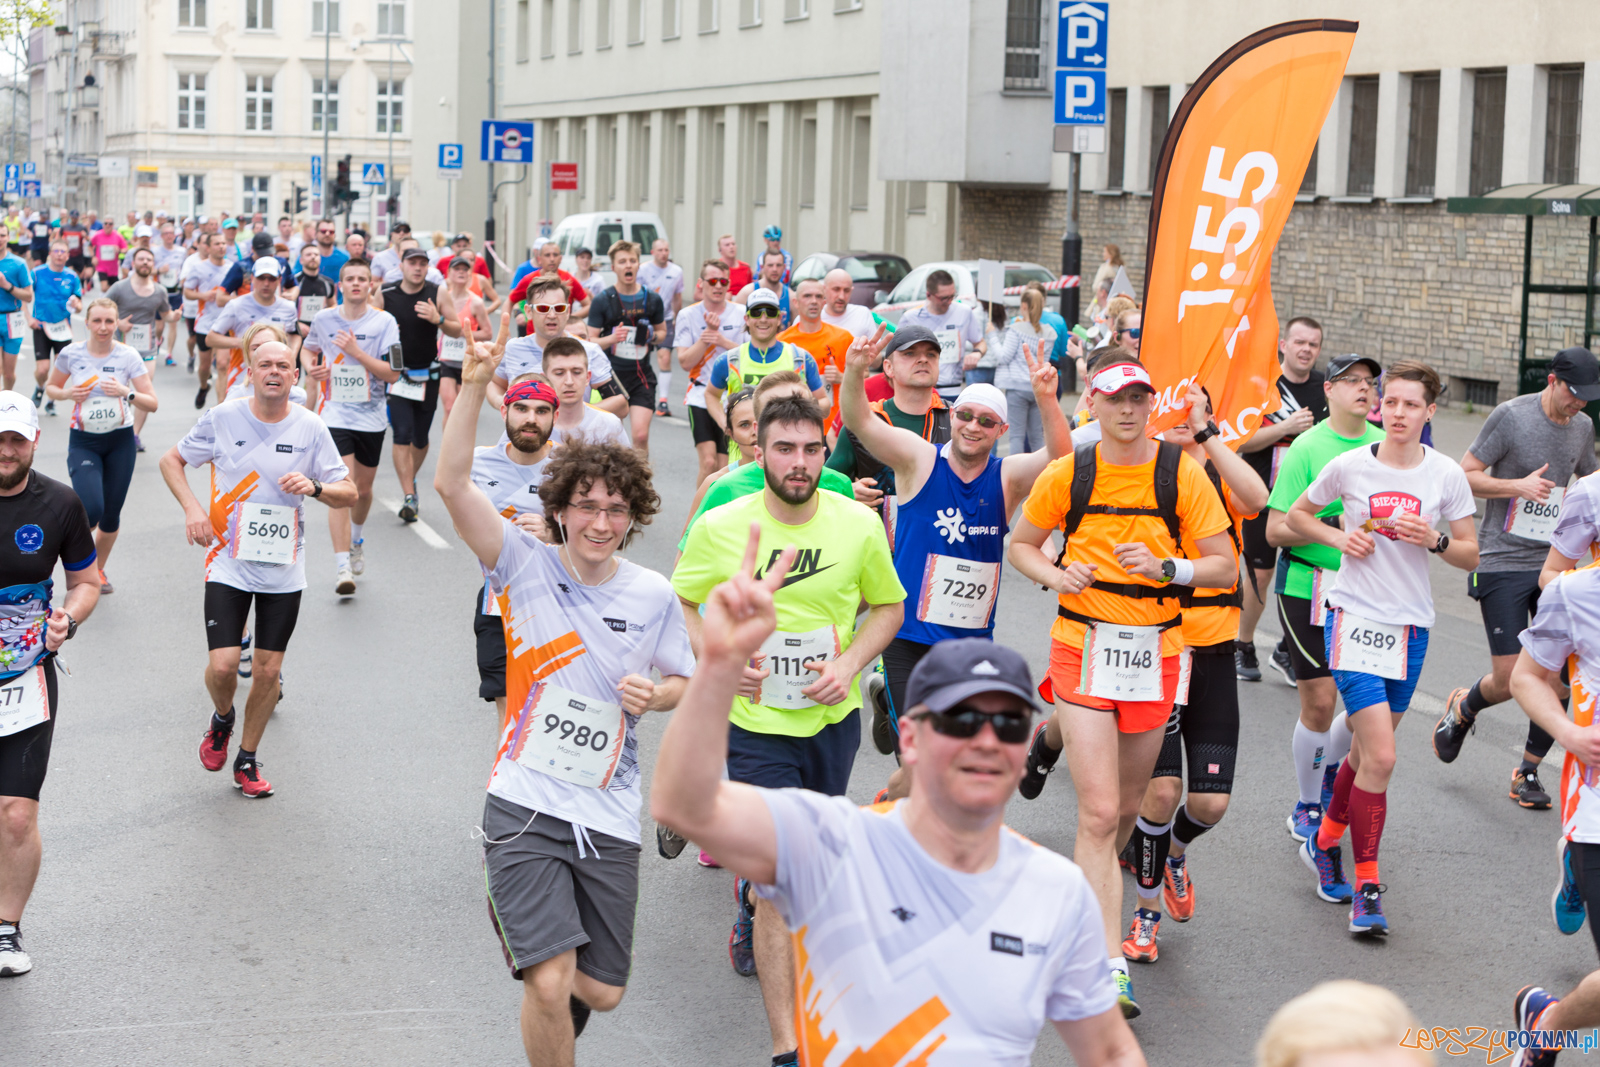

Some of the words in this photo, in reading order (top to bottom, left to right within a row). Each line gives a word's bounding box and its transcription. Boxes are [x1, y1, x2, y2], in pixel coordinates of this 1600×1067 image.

[1067, 16, 1098, 59] P
[1065, 76, 1096, 118] P
[443, 145, 459, 166] P
[1551, 200, 1571, 213] Solna
[1178, 145, 1279, 324] 1:55
[333, 376, 365, 387] 11390
[88, 408, 116, 420] 2816
[1371, 496, 1419, 511] BIEGAM
[1523, 500, 1560, 518] 8860
[247, 521, 290, 539] 5690
[942, 578, 987, 601] 7229
[1349, 627, 1396, 651] 4589
[1103, 647, 1152, 669] 11148
[0, 686, 24, 706] 77
[543, 713, 609, 752] 9980
[556, 745, 581, 758] Marcin
